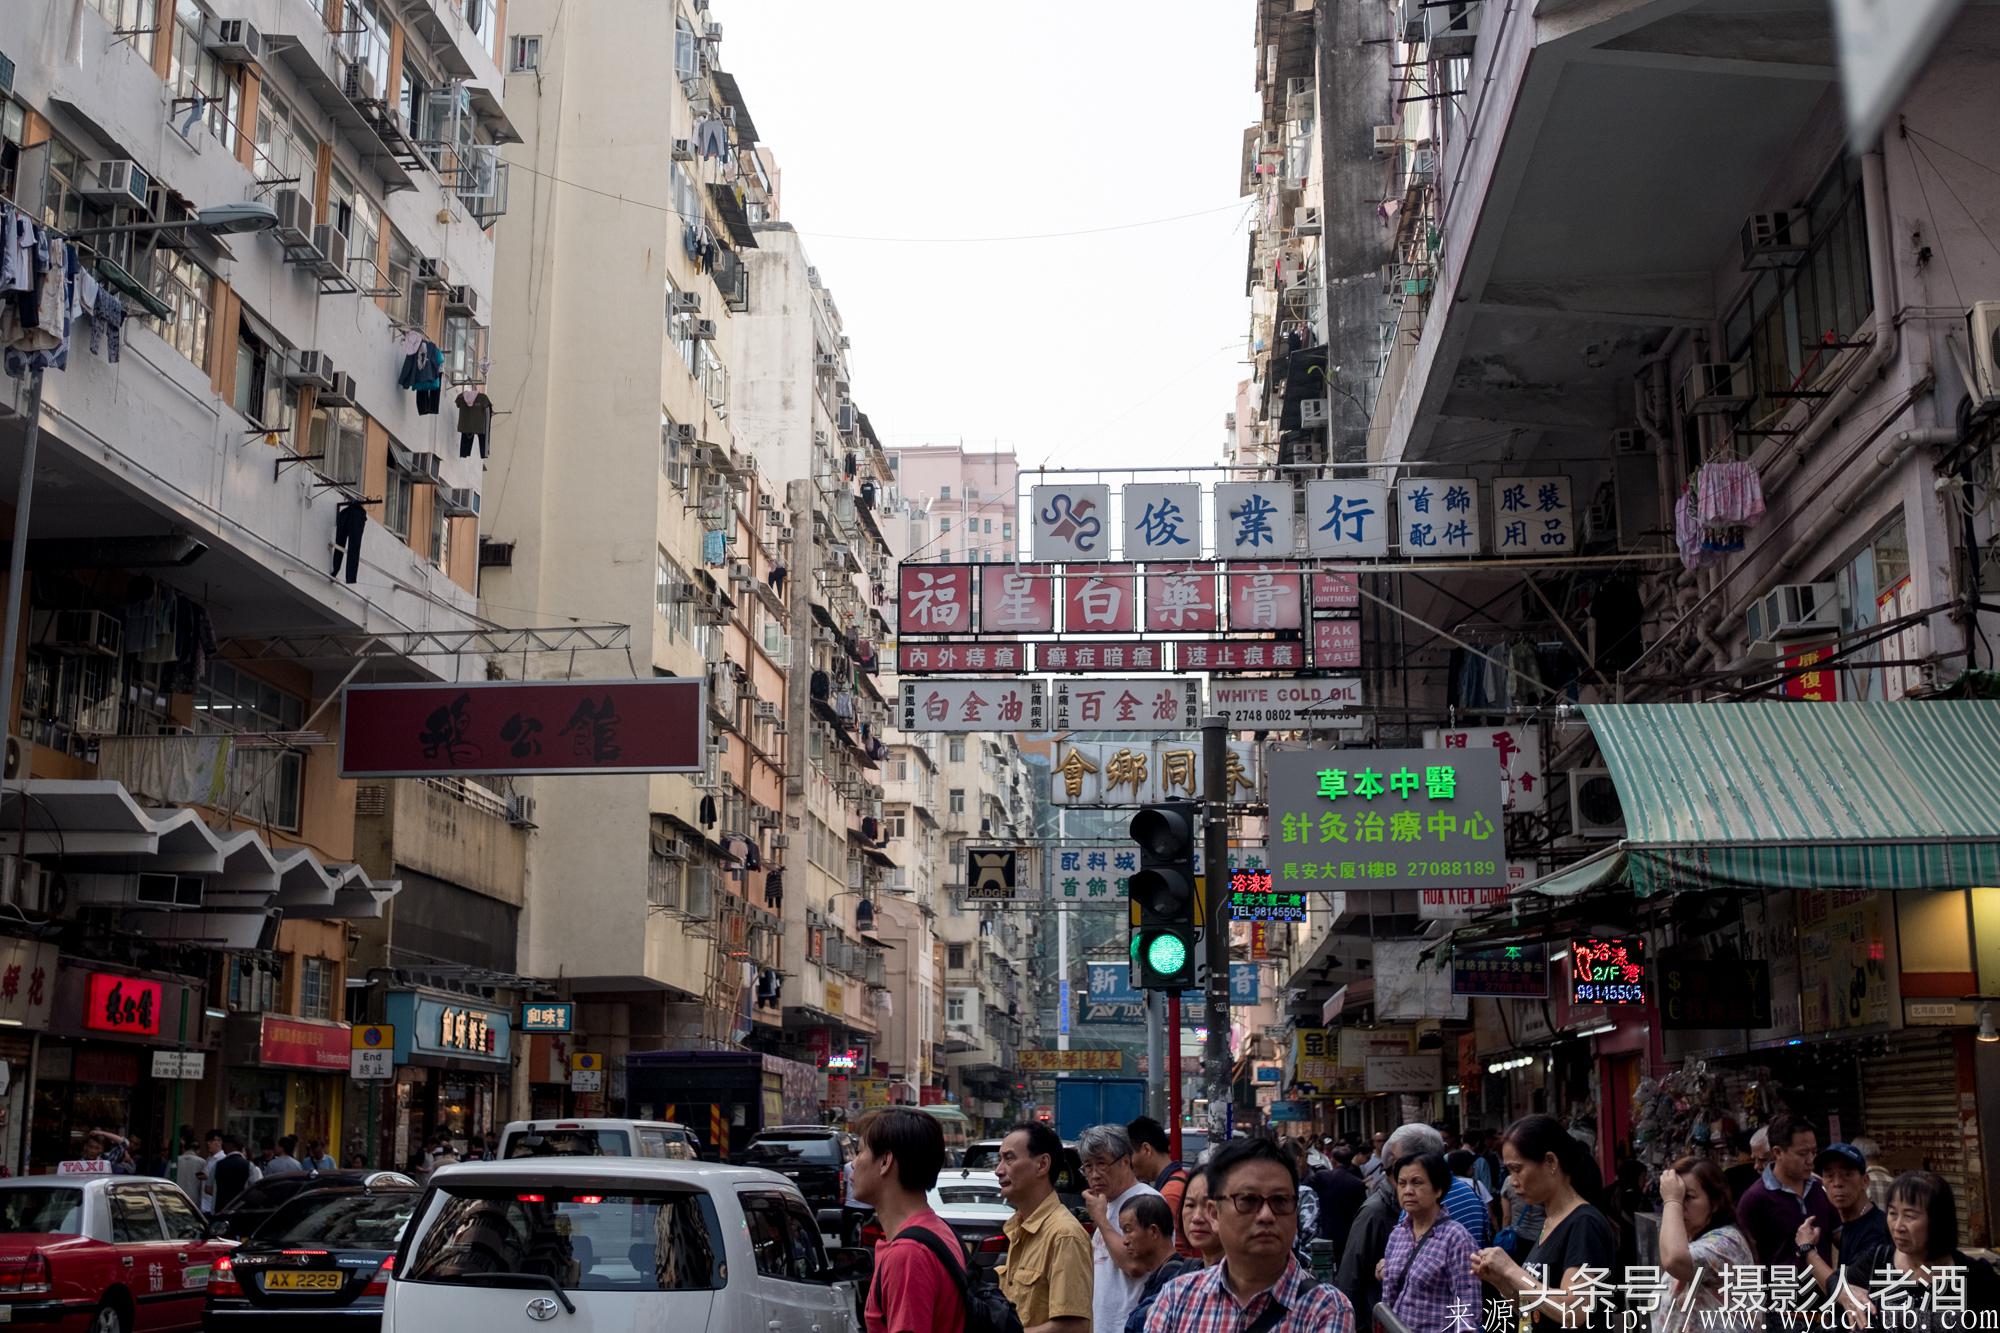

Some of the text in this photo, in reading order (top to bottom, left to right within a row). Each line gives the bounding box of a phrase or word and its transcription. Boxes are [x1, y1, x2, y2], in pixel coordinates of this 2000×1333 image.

[1407, 487, 1471, 513] 首飾
[1500, 486, 1566, 512] 服裝
[1135, 494, 1376, 548] 俊業行
[1408, 520, 1472, 547] 配件
[1503, 519, 1568, 547] 用品
[908, 566, 1294, 630] 福星白藥膏
[1321, 585, 1350, 593] WHITE
[1315, 595, 1357, 603] OINTMENT
[1321, 625, 1353, 636] PAK
[1321, 639, 1354, 649] KAM
[1323, 653, 1353, 662] YAU
[1216, 687, 1357, 703] WHITE GOLD OIL
[921, 689, 1024, 723] 白金油
[1058, 684, 1070, 729] 止痛止血
[1075, 688, 1179, 723] 百金油
[1235, 709, 1263, 722] 2748
[1265, 709, 1292, 721] 0802
[1315, 765, 1457, 801] 草本中醫
[1281, 809, 1496, 845] 針灸治療中心
[1061, 851, 1135, 872] 配料城
[1407, 860, 1496, 878] 27088189
[969, 887, 1014, 898] GADGET
[1593, 966, 1620, 982] 2/F
[363, 1052, 382, 1062] End
[63, 1160, 105, 1174] TAXI
[269, 1273, 338, 1288] AX 2229
